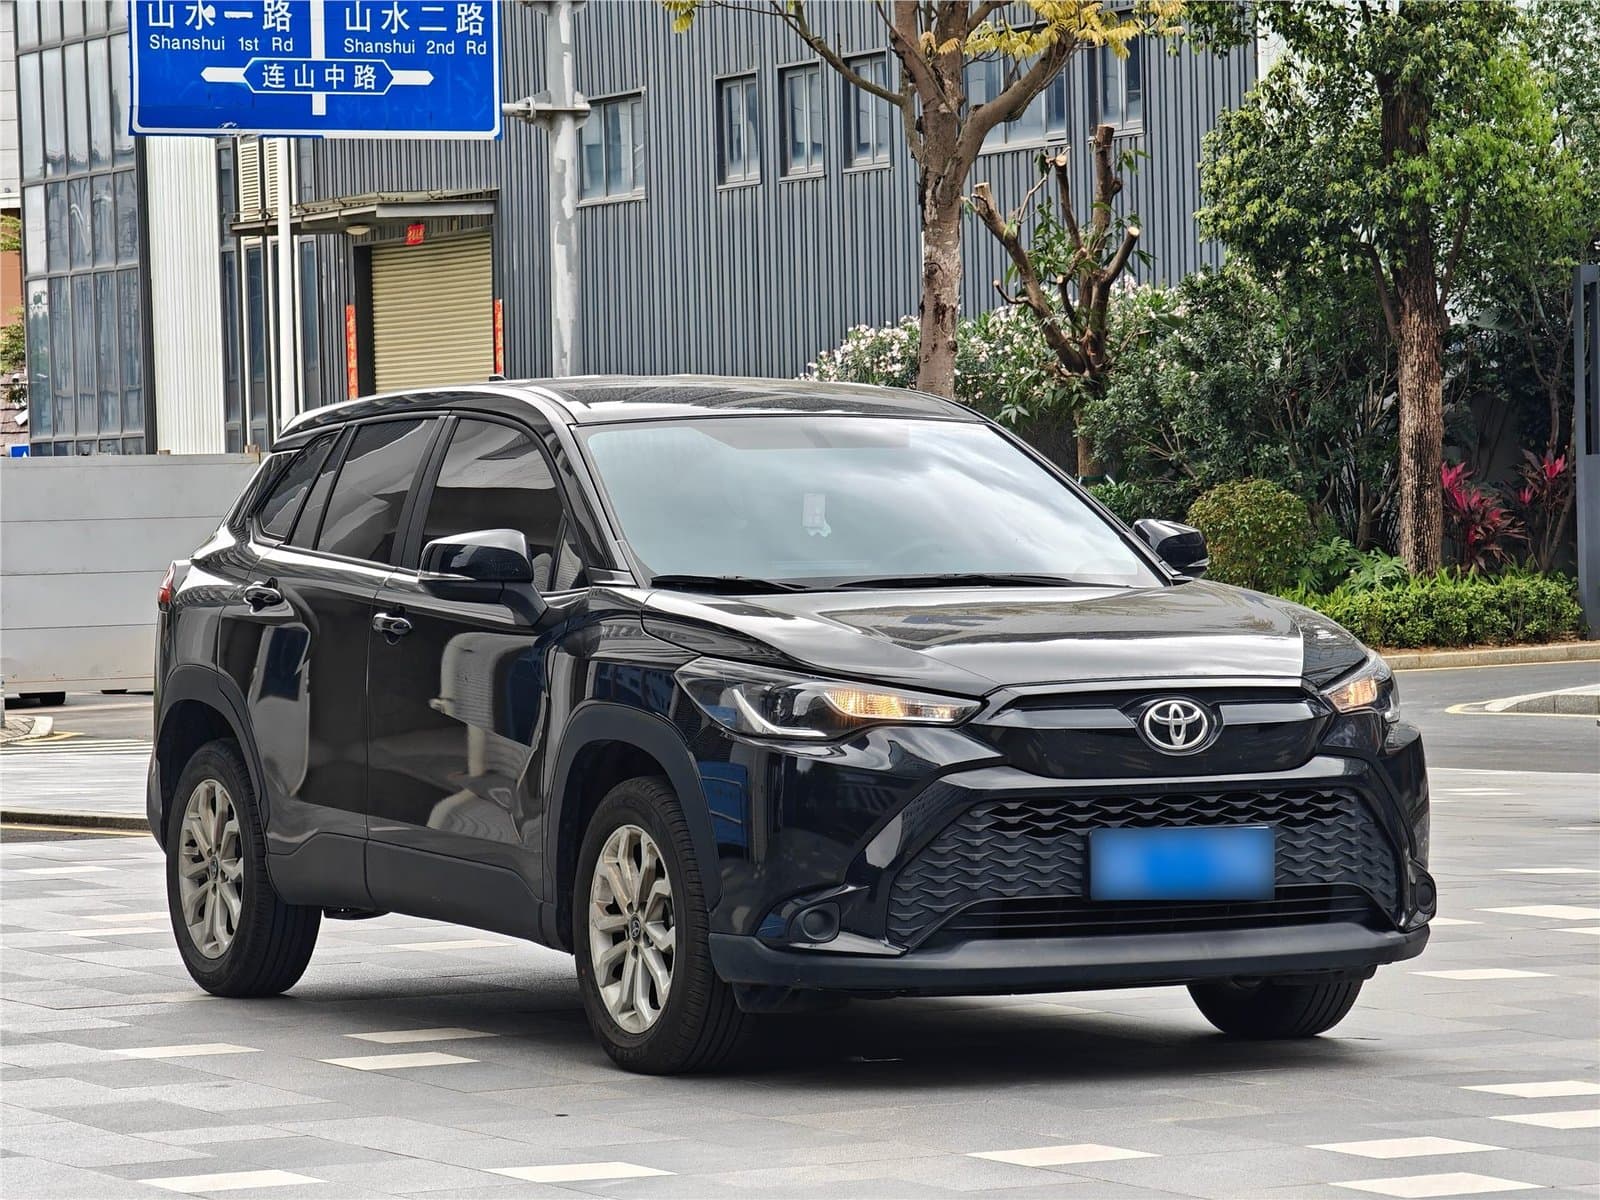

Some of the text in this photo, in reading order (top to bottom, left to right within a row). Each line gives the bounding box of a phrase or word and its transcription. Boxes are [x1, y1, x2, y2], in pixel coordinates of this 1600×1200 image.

[148, 0, 292, 32] 山水一路
[345, 1, 485, 36] 山水二路
[149, 34, 294, 52] Shanshui 1st Rd
[344, 38, 487, 55] Shanshui 2nd Rd
[262, 63, 377, 90] 连山中路
